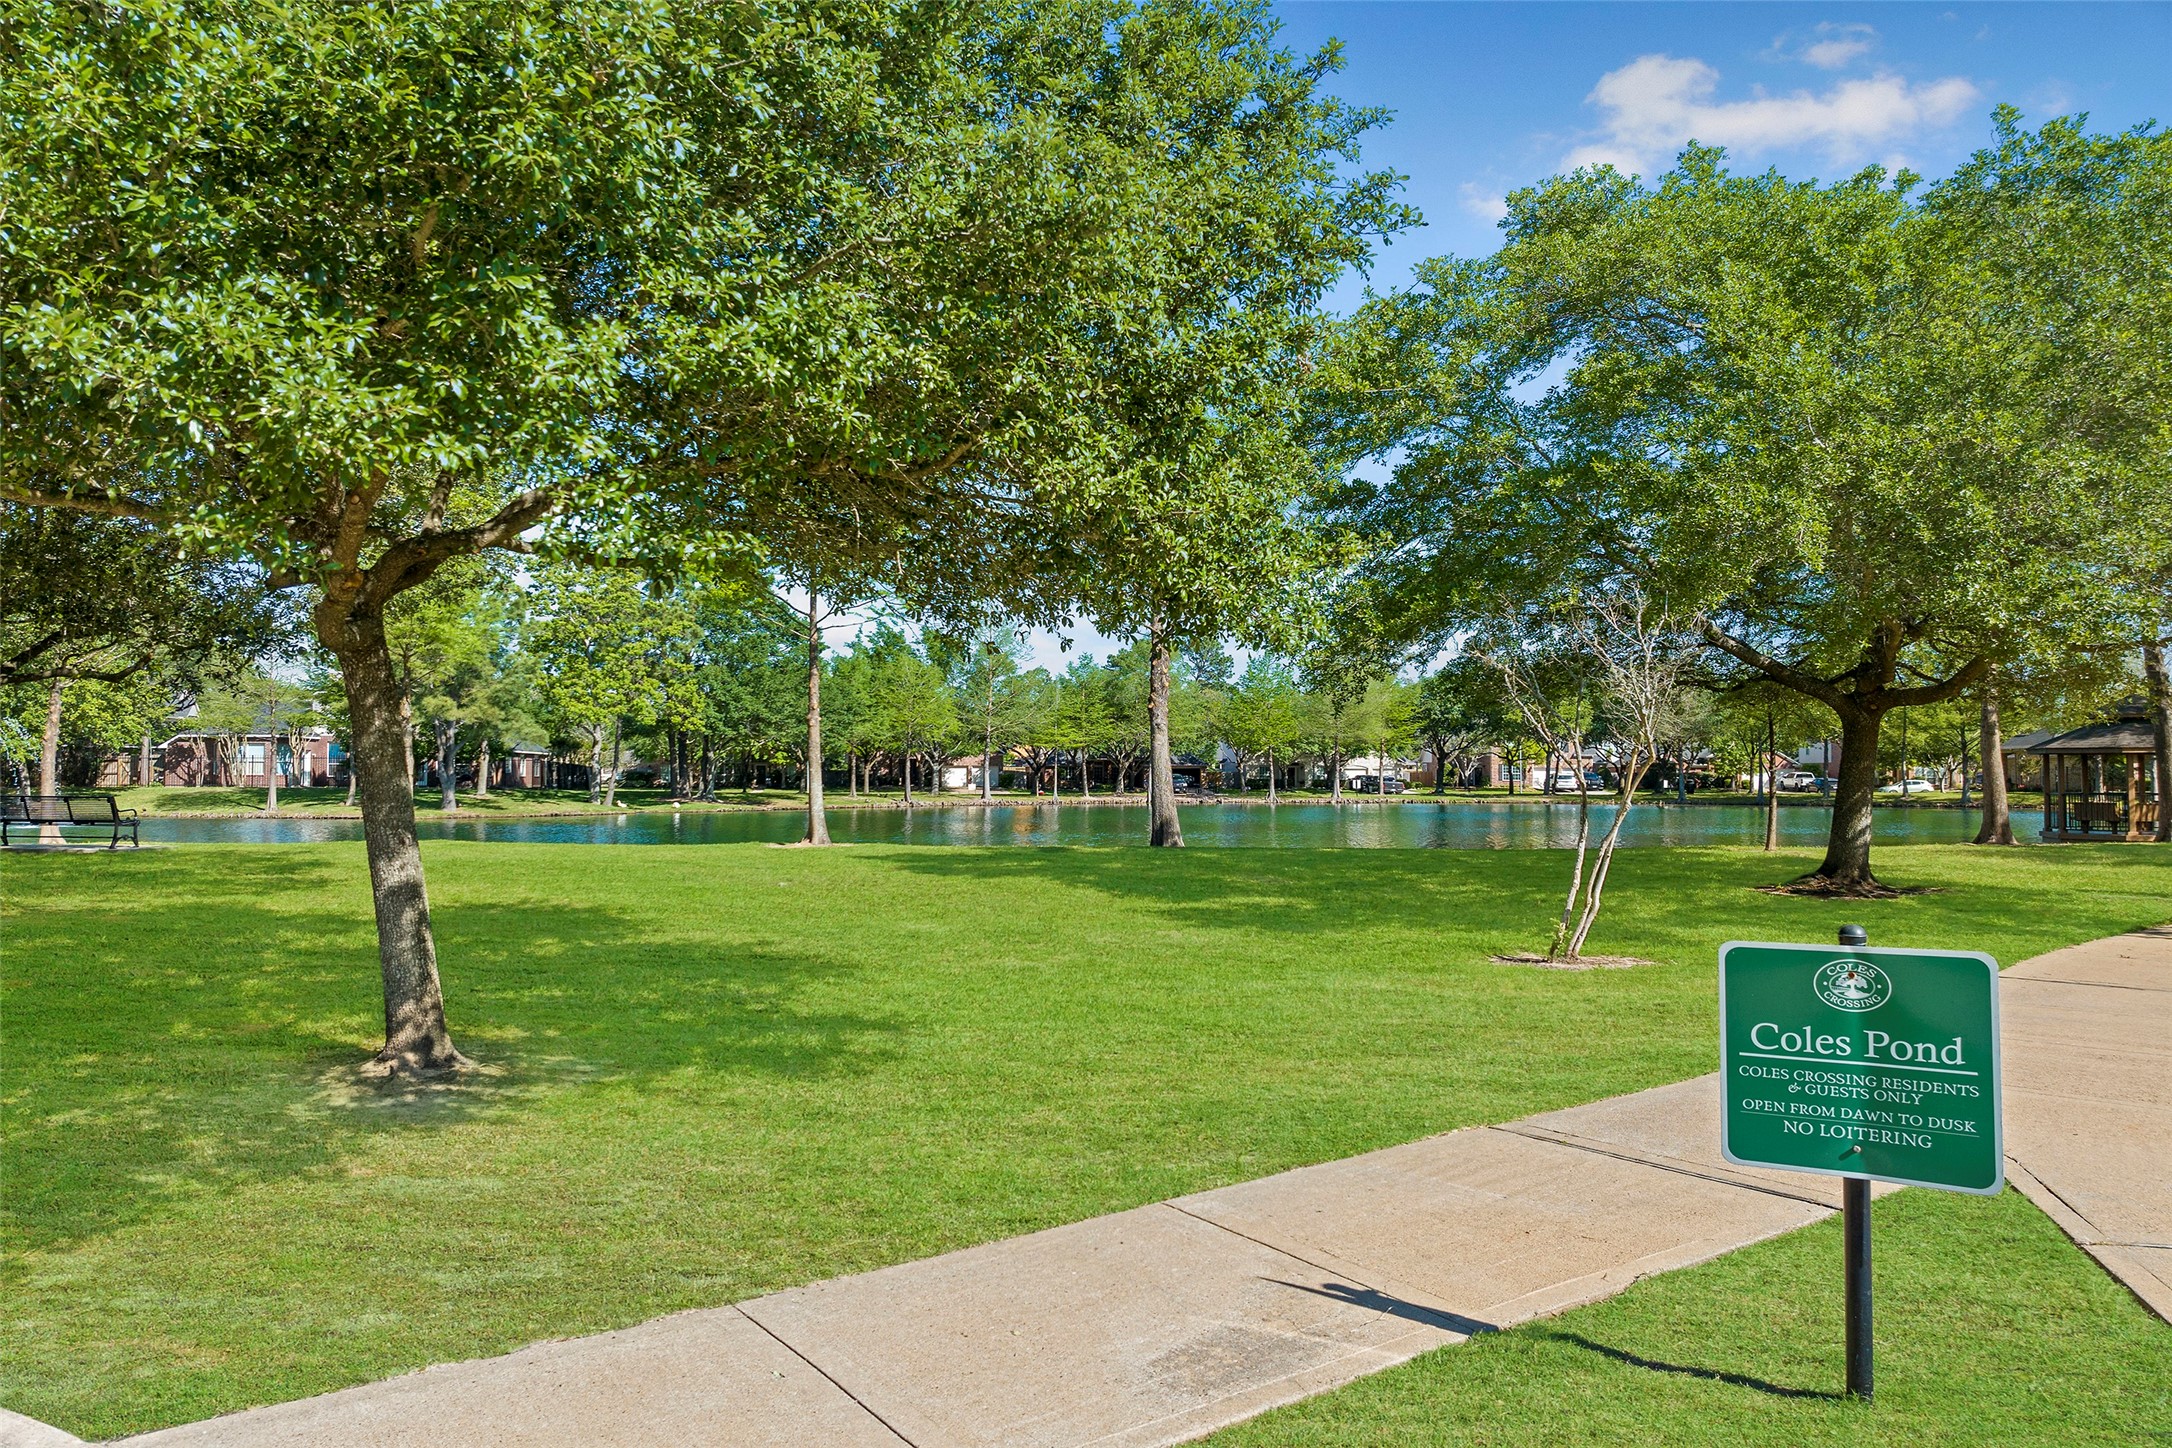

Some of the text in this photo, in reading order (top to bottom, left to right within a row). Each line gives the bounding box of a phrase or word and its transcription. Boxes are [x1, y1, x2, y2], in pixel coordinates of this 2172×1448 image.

[1826, 963, 1877, 978] COLES
[1824, 990, 1881, 1008] CROSSING
[1750, 1022, 1965, 1065] Coles Pond
[1739, 1066, 1979, 1097] COLES CROSSING RESIDENTS
[1788, 1082, 1922, 1106] & GUESTS ONLY
[1742, 1098, 1976, 1133] OPEN FROM DAWN TO DUSK
[1784, 1120, 1932, 1148] NO LOITERING
